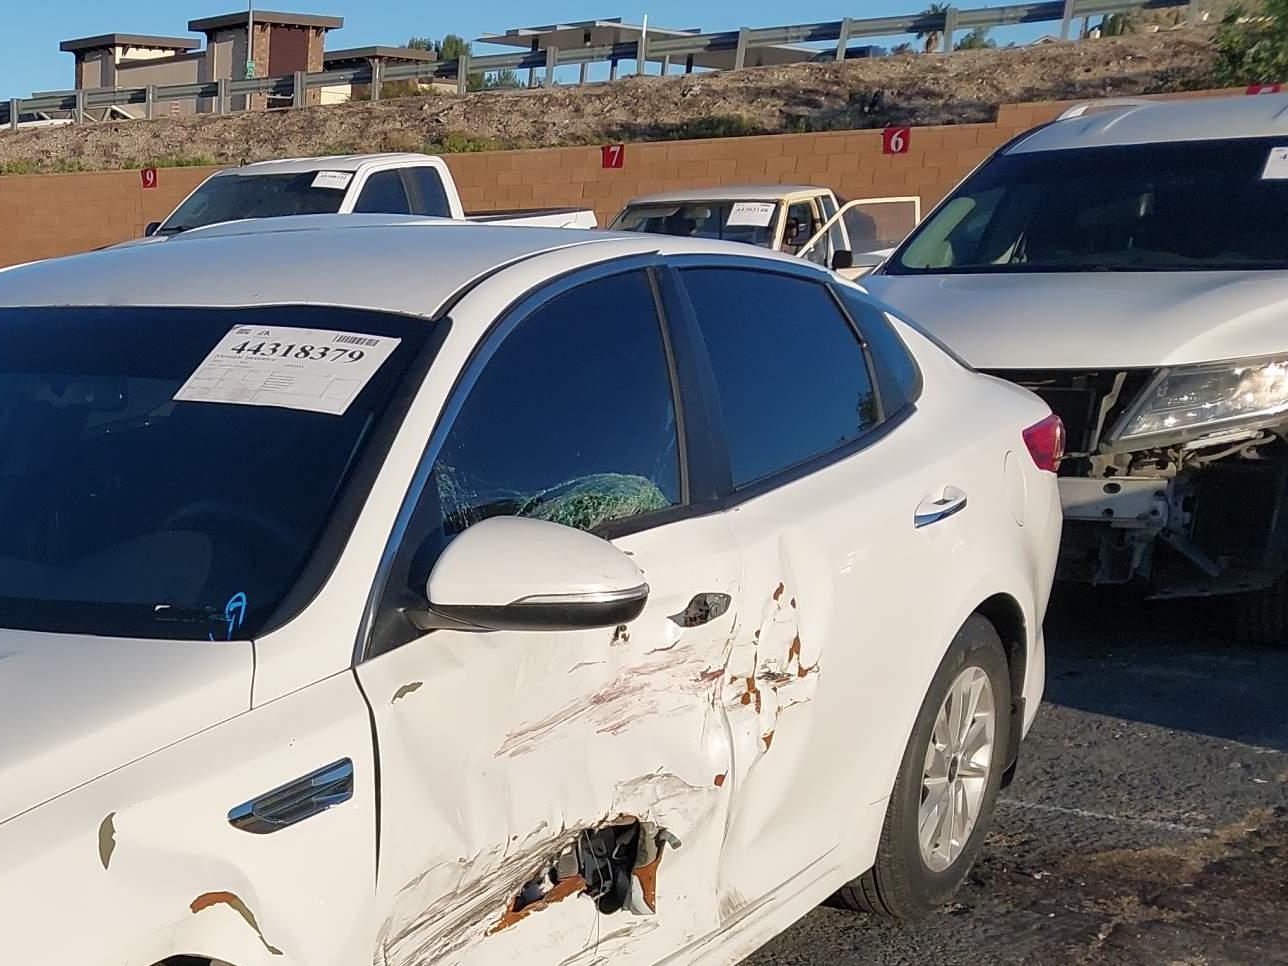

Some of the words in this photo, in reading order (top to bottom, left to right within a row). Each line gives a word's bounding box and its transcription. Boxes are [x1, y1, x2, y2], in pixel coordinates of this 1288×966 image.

[890, 129, 905, 152] 6
[609, 145, 621, 167] 7
[145, 169, 154, 187] 9
[231, 341, 365, 363] 44318379
